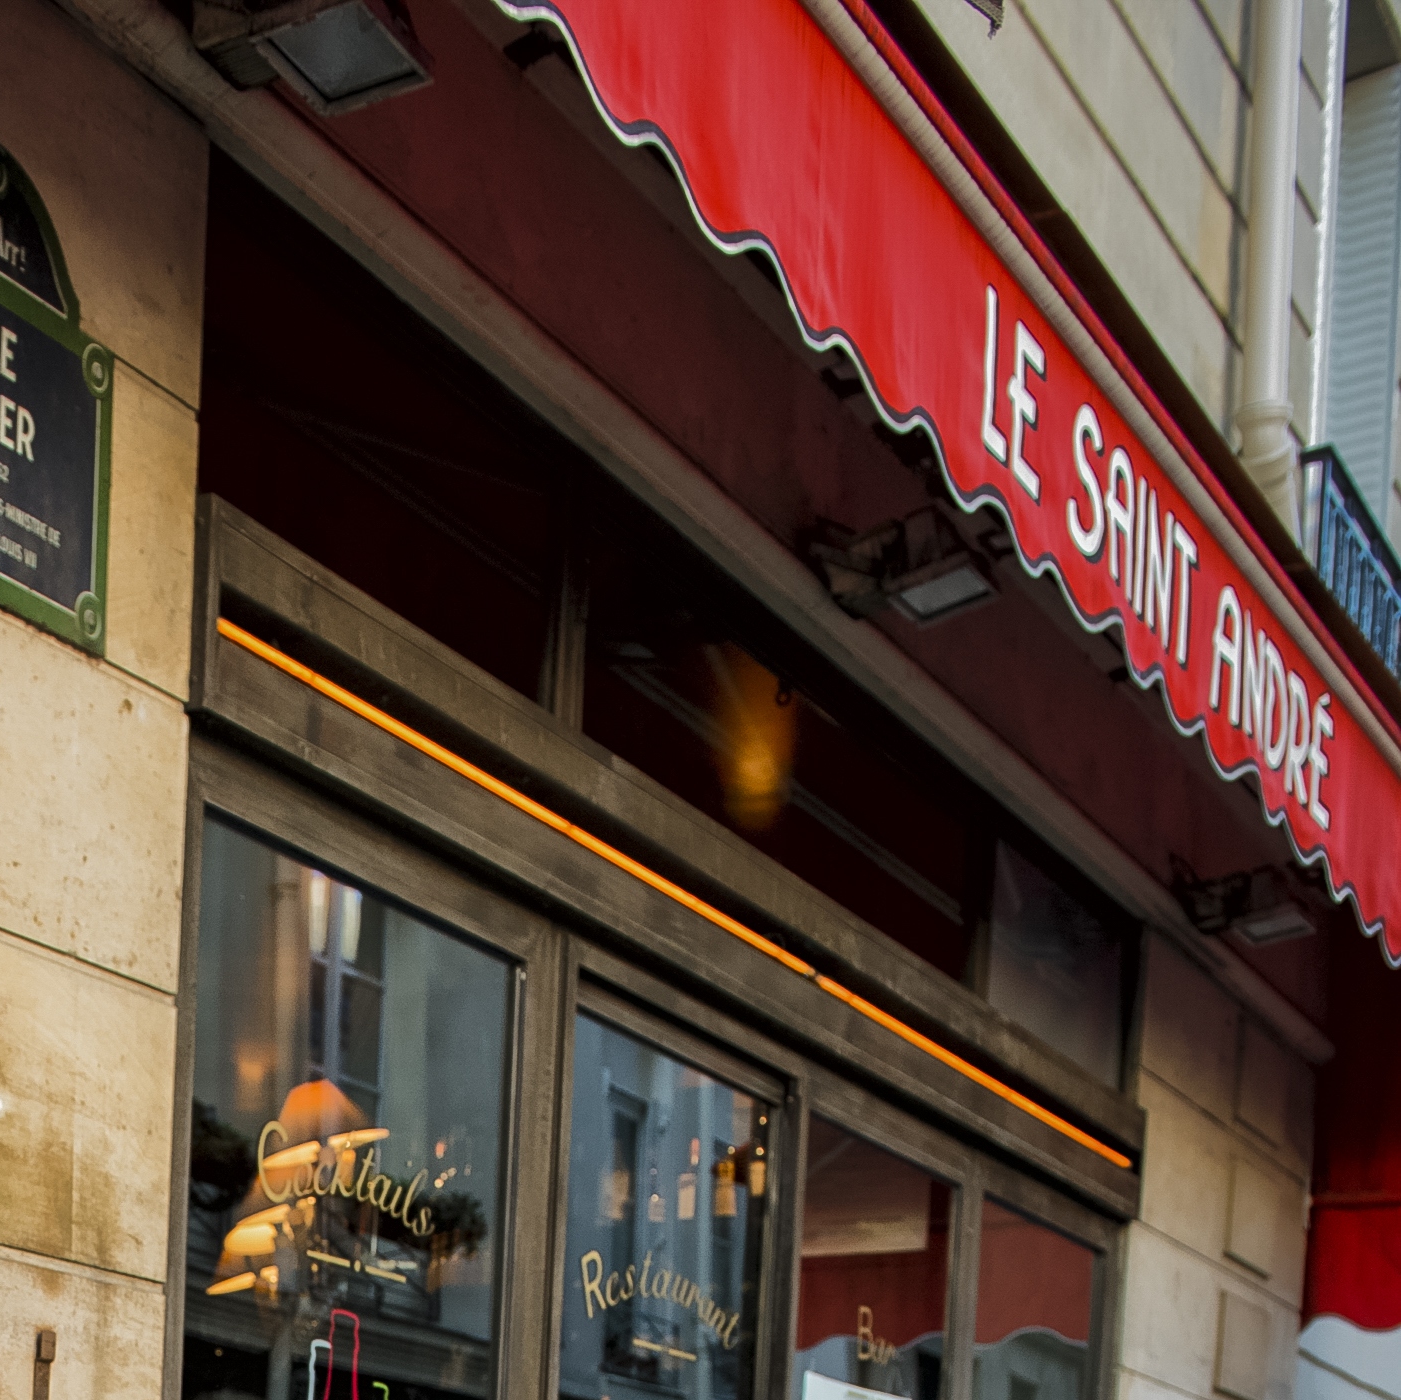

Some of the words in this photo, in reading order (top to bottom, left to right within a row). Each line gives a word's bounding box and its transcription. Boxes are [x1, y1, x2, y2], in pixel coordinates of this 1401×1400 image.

[981, 283, 1047, 503] LE
[1066, 401, 1198, 670] SAINT
[1209, 584, 1335, 832] ANDRÉ
[257, 1120, 436, 1237] Cocktails
[581, 1249, 740, 1350] Restaurant
